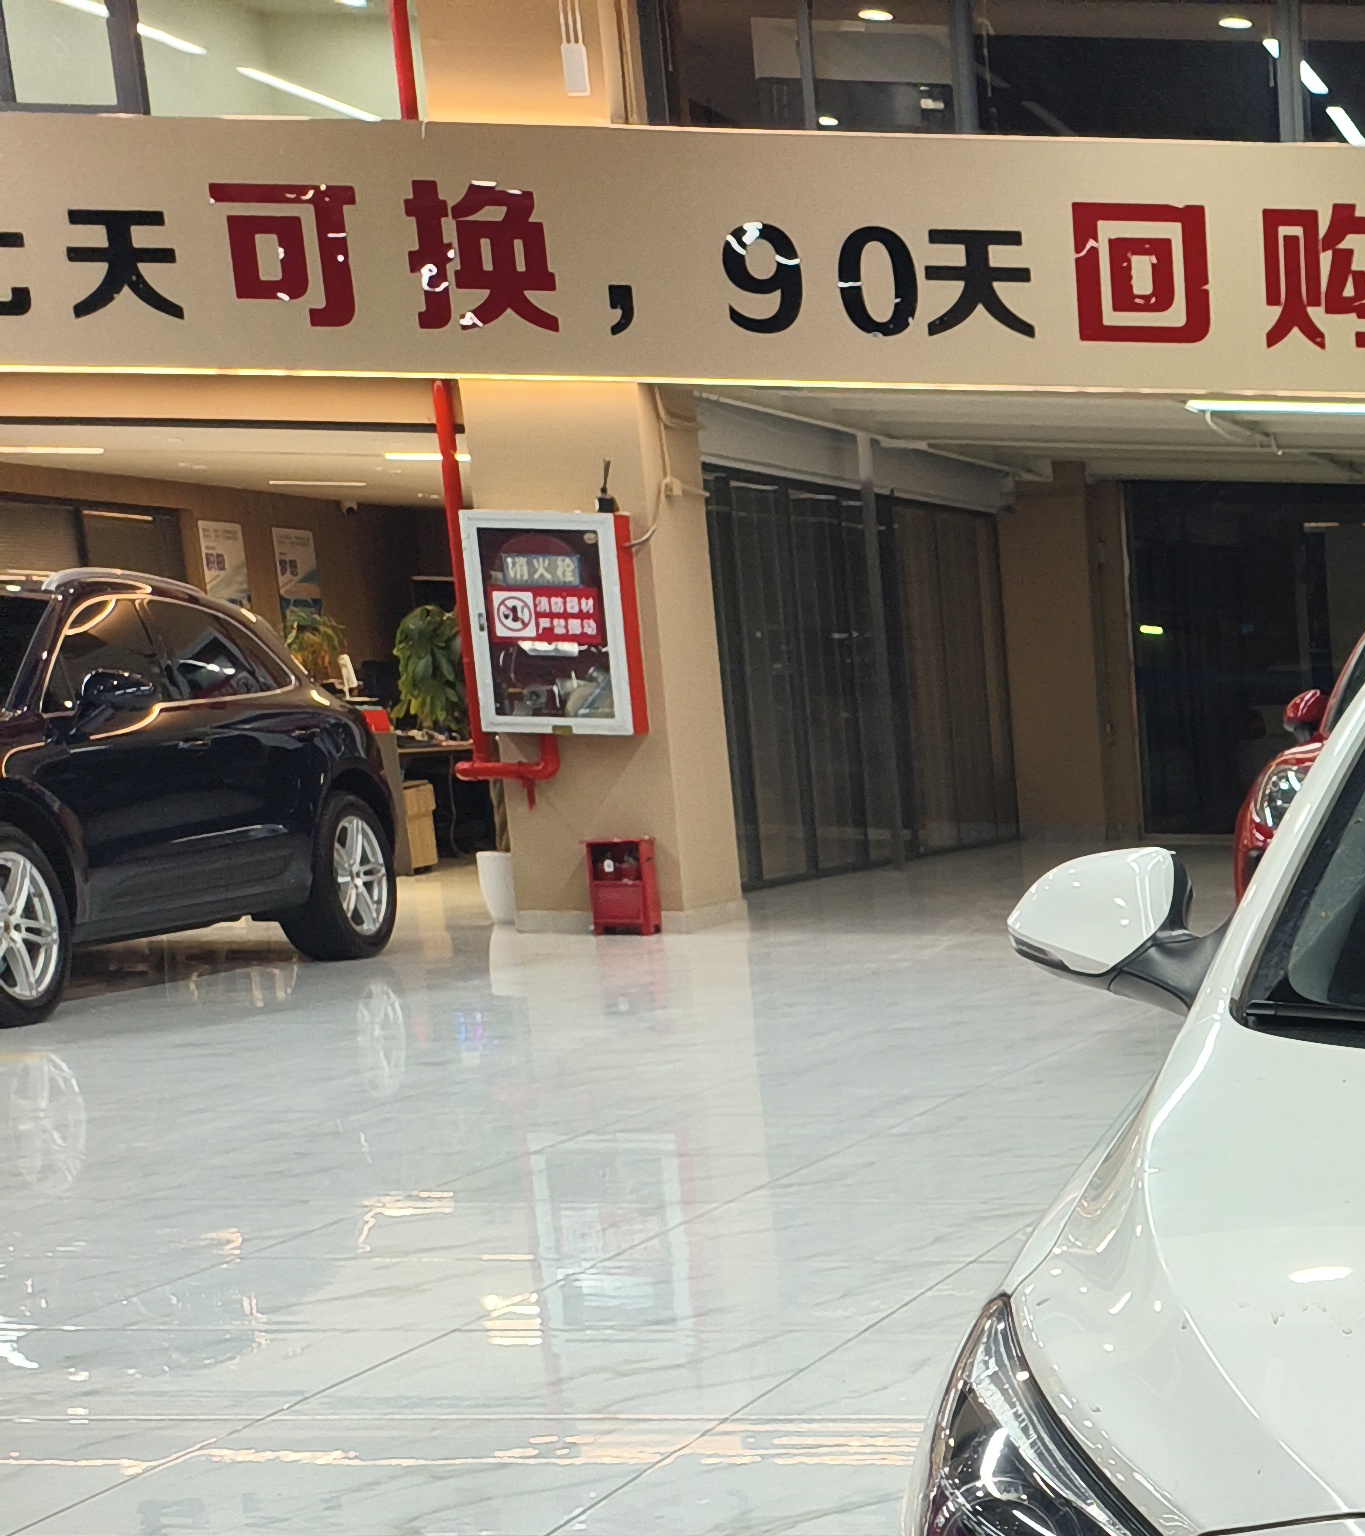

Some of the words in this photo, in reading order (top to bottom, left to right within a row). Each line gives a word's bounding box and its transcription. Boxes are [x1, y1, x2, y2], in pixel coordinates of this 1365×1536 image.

[506, 556, 575, 579] 消火栓
[535, 596, 594, 614] 消防器材
